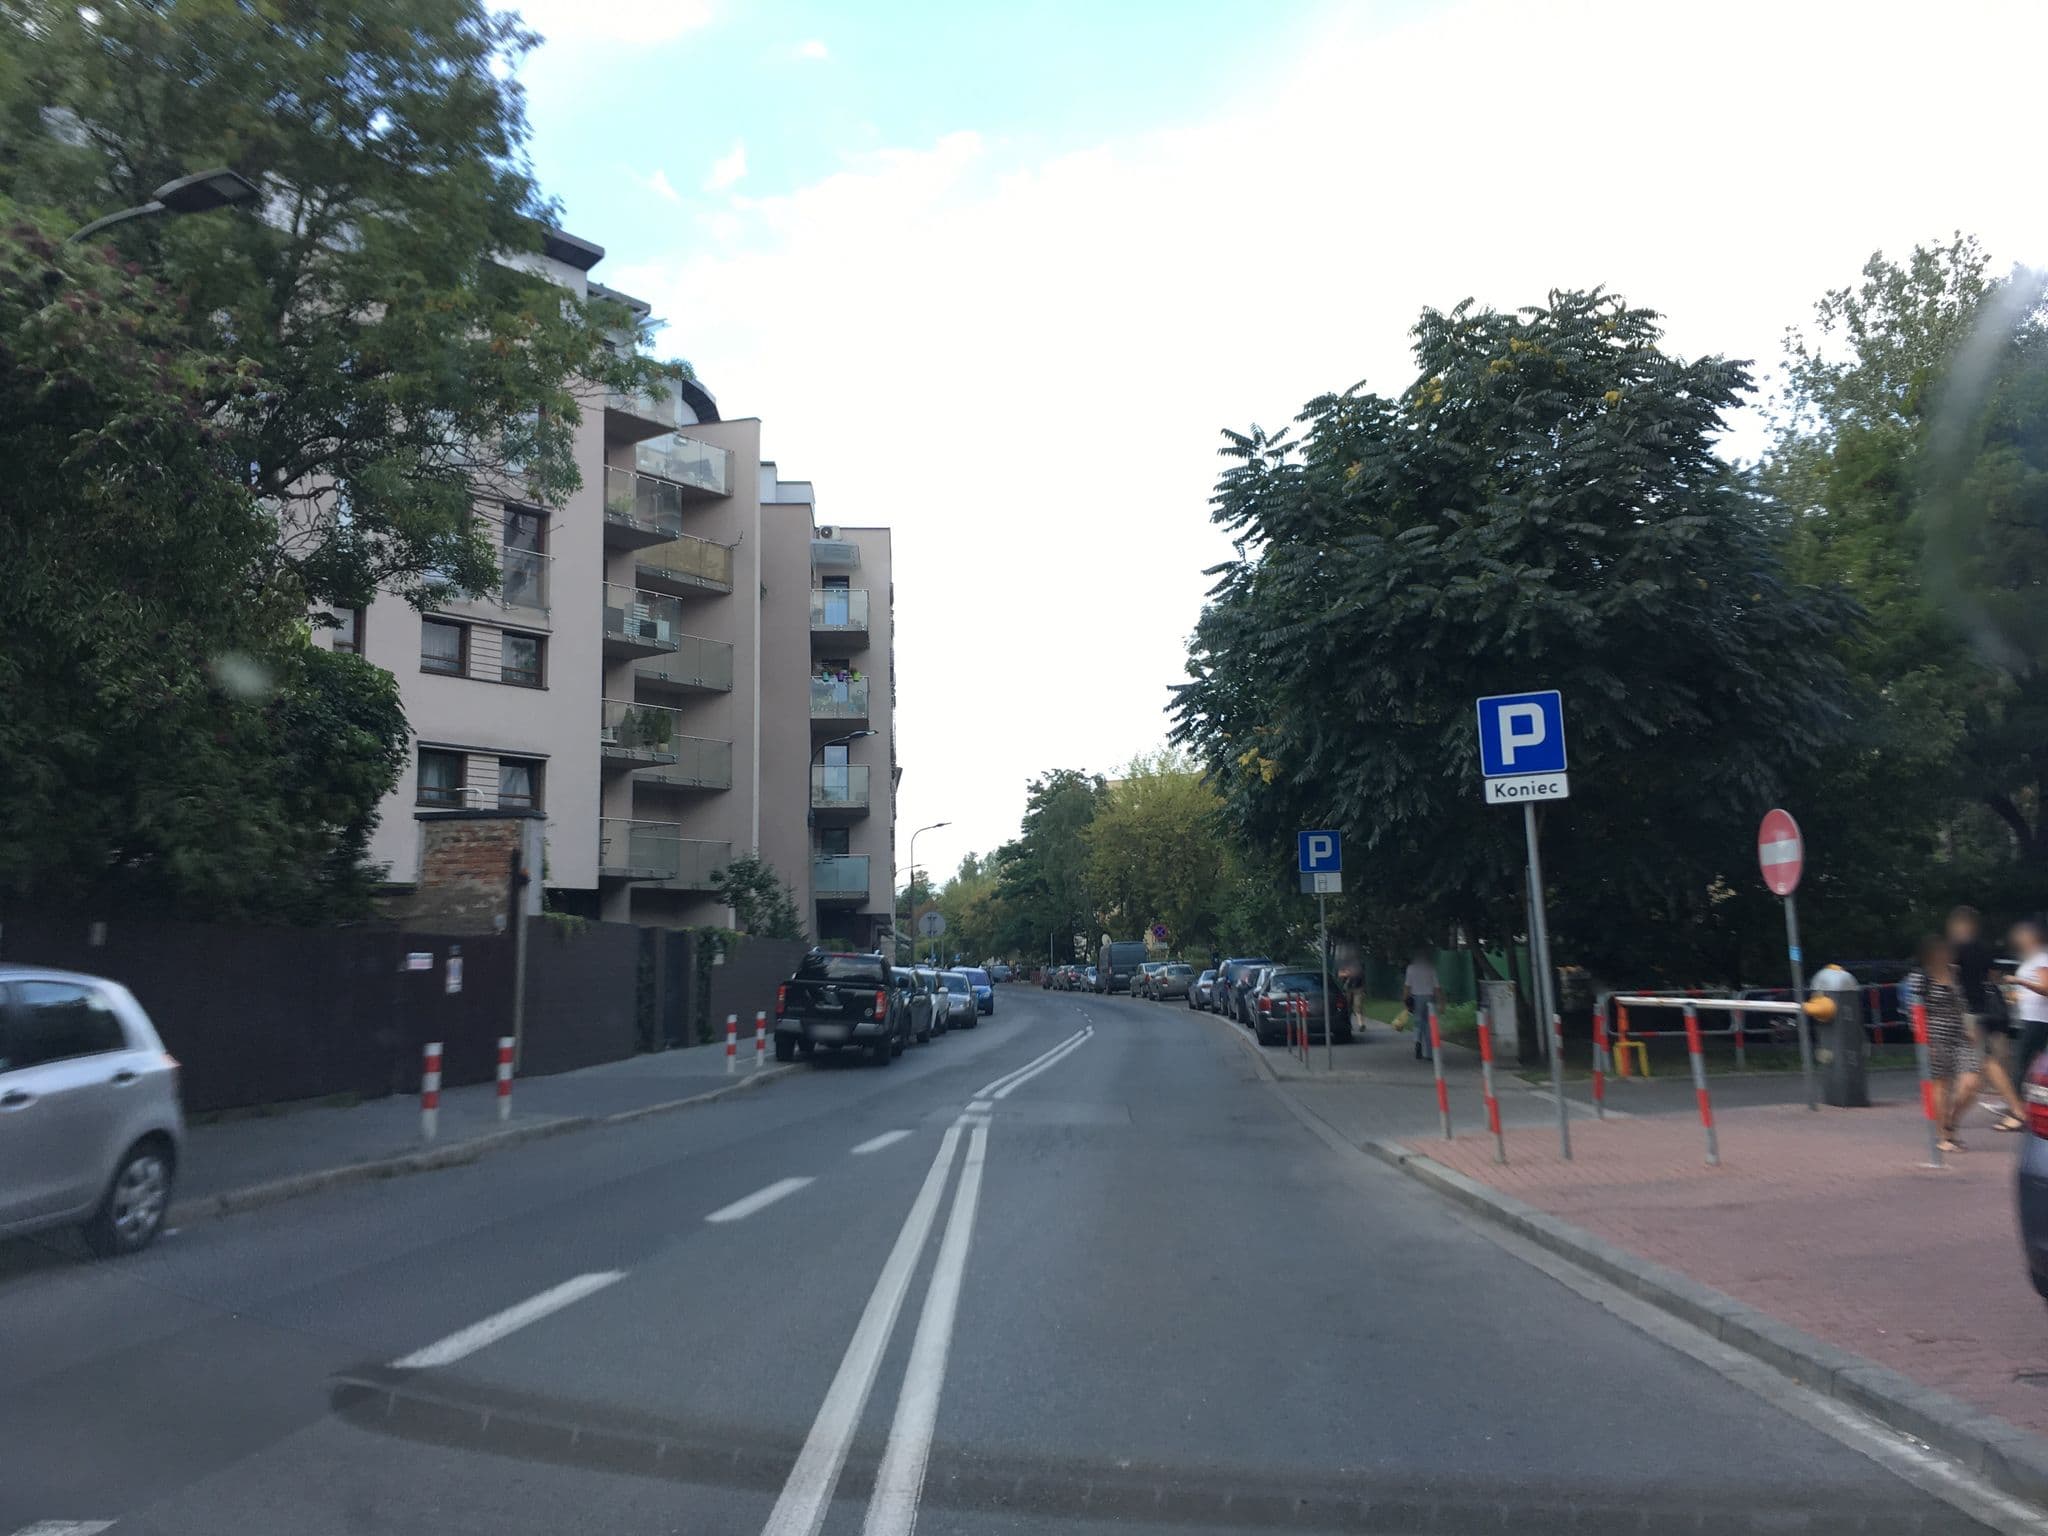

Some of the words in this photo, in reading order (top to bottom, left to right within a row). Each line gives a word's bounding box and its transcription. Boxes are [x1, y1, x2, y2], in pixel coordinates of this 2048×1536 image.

[1498, 703, 1545, 765] P
[1495, 781, 1558, 798] Koniec
[1309, 836, 1332, 867] P
